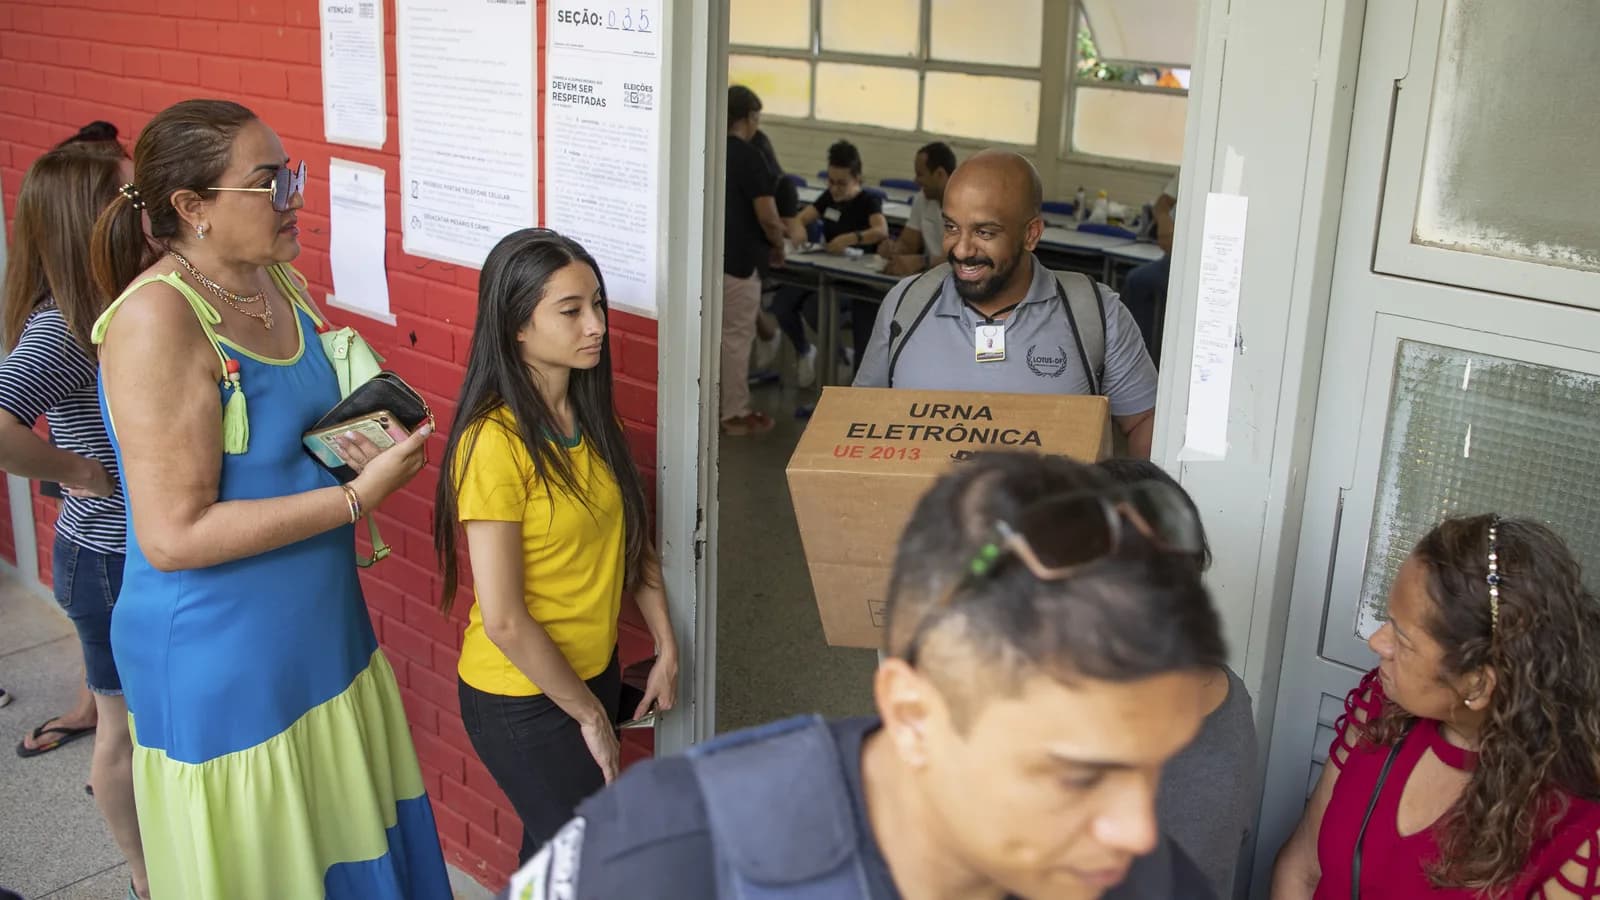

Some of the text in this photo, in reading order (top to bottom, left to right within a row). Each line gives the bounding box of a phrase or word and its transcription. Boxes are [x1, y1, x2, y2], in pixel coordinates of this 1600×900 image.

[557, 8, 603, 26] SEÇÃO:
[552, 81, 593, 94] DEVEM SER
[623, 82, 653, 93] ELEIÇÕES
[552, 92, 607, 108] RESPEITADAS
[909, 403, 993, 421] URNA
[846, 421, 1042, 447] ELETRÔNICA
[833, 444, 922, 461] UE 2013
